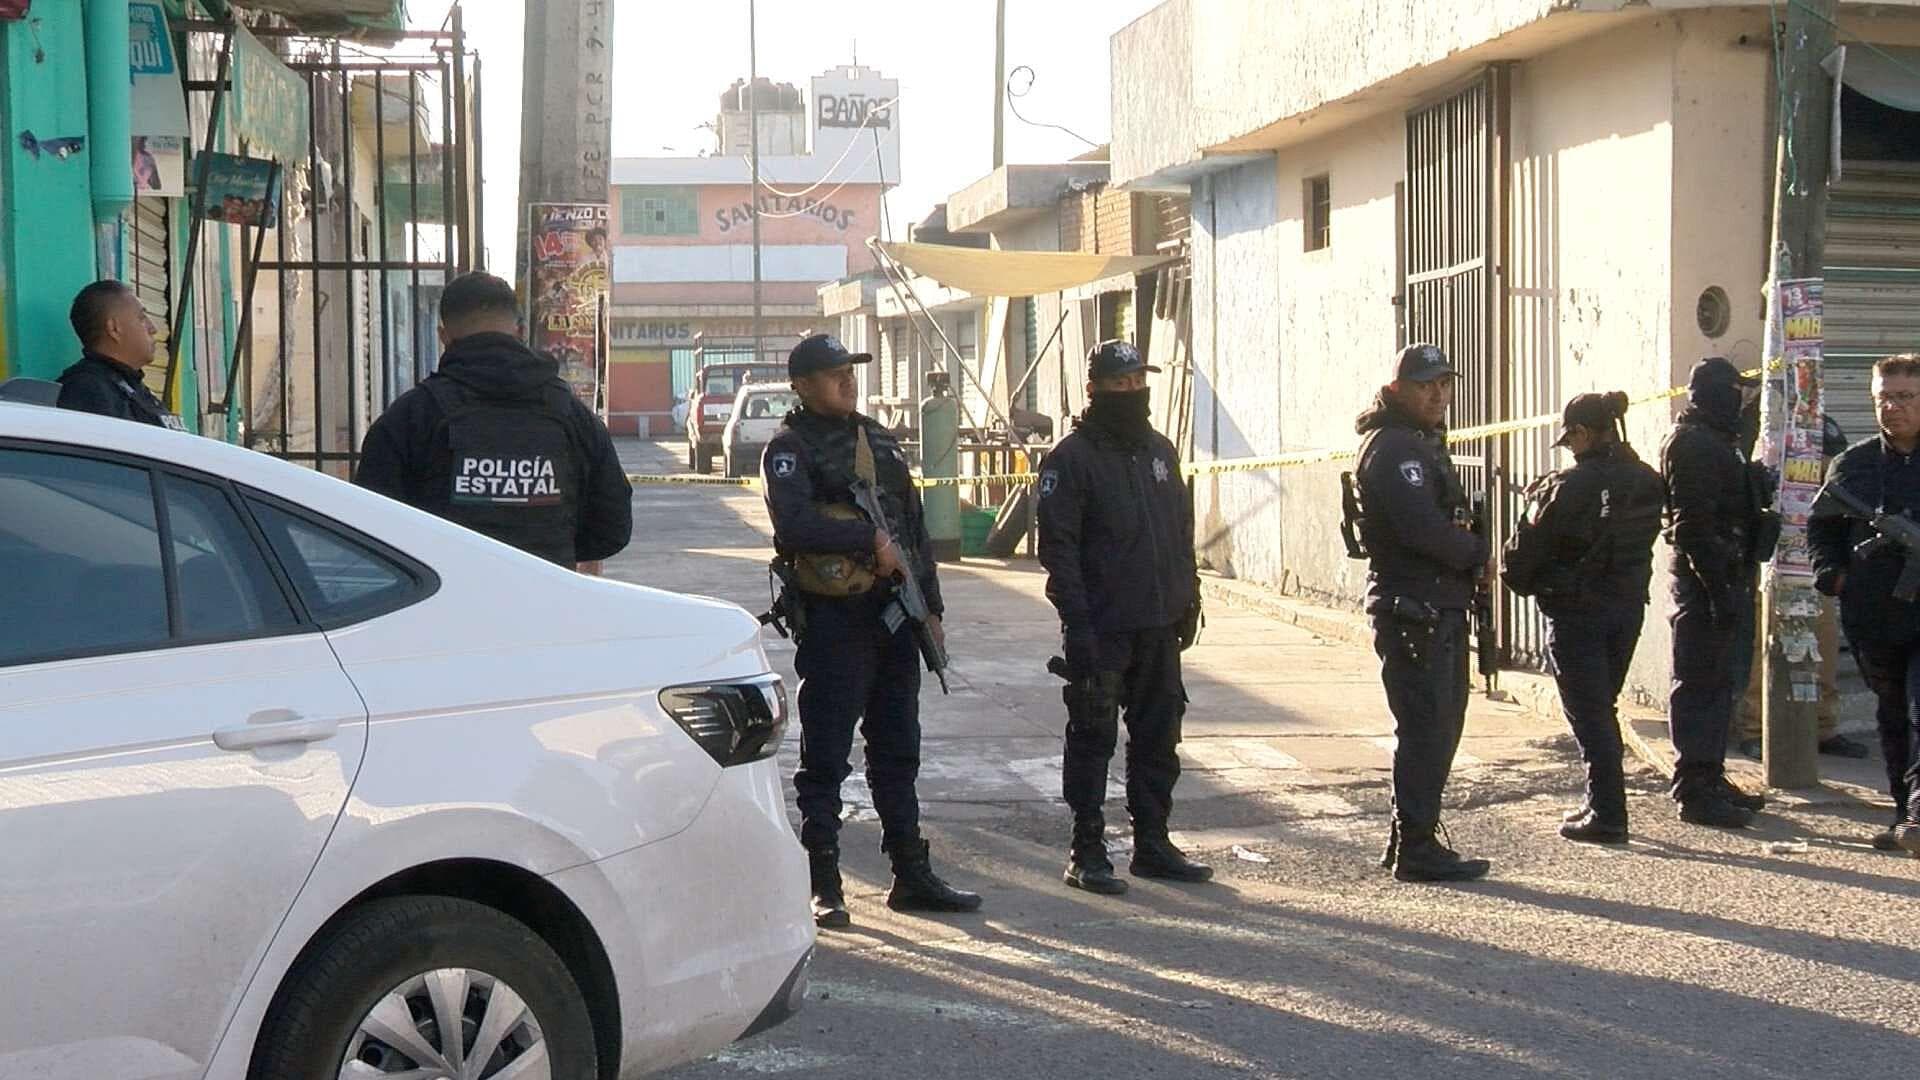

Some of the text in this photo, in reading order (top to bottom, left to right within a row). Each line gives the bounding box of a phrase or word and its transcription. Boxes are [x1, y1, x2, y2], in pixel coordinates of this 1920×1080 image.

[818, 93, 891, 124] BAÑOS
[715, 195, 856, 232] SANITARIOS
[608, 322, 689, 339] NITARIOS
[462, 455, 555, 478] POLICÍA
[455, 475, 561, 495] ESTATAL
